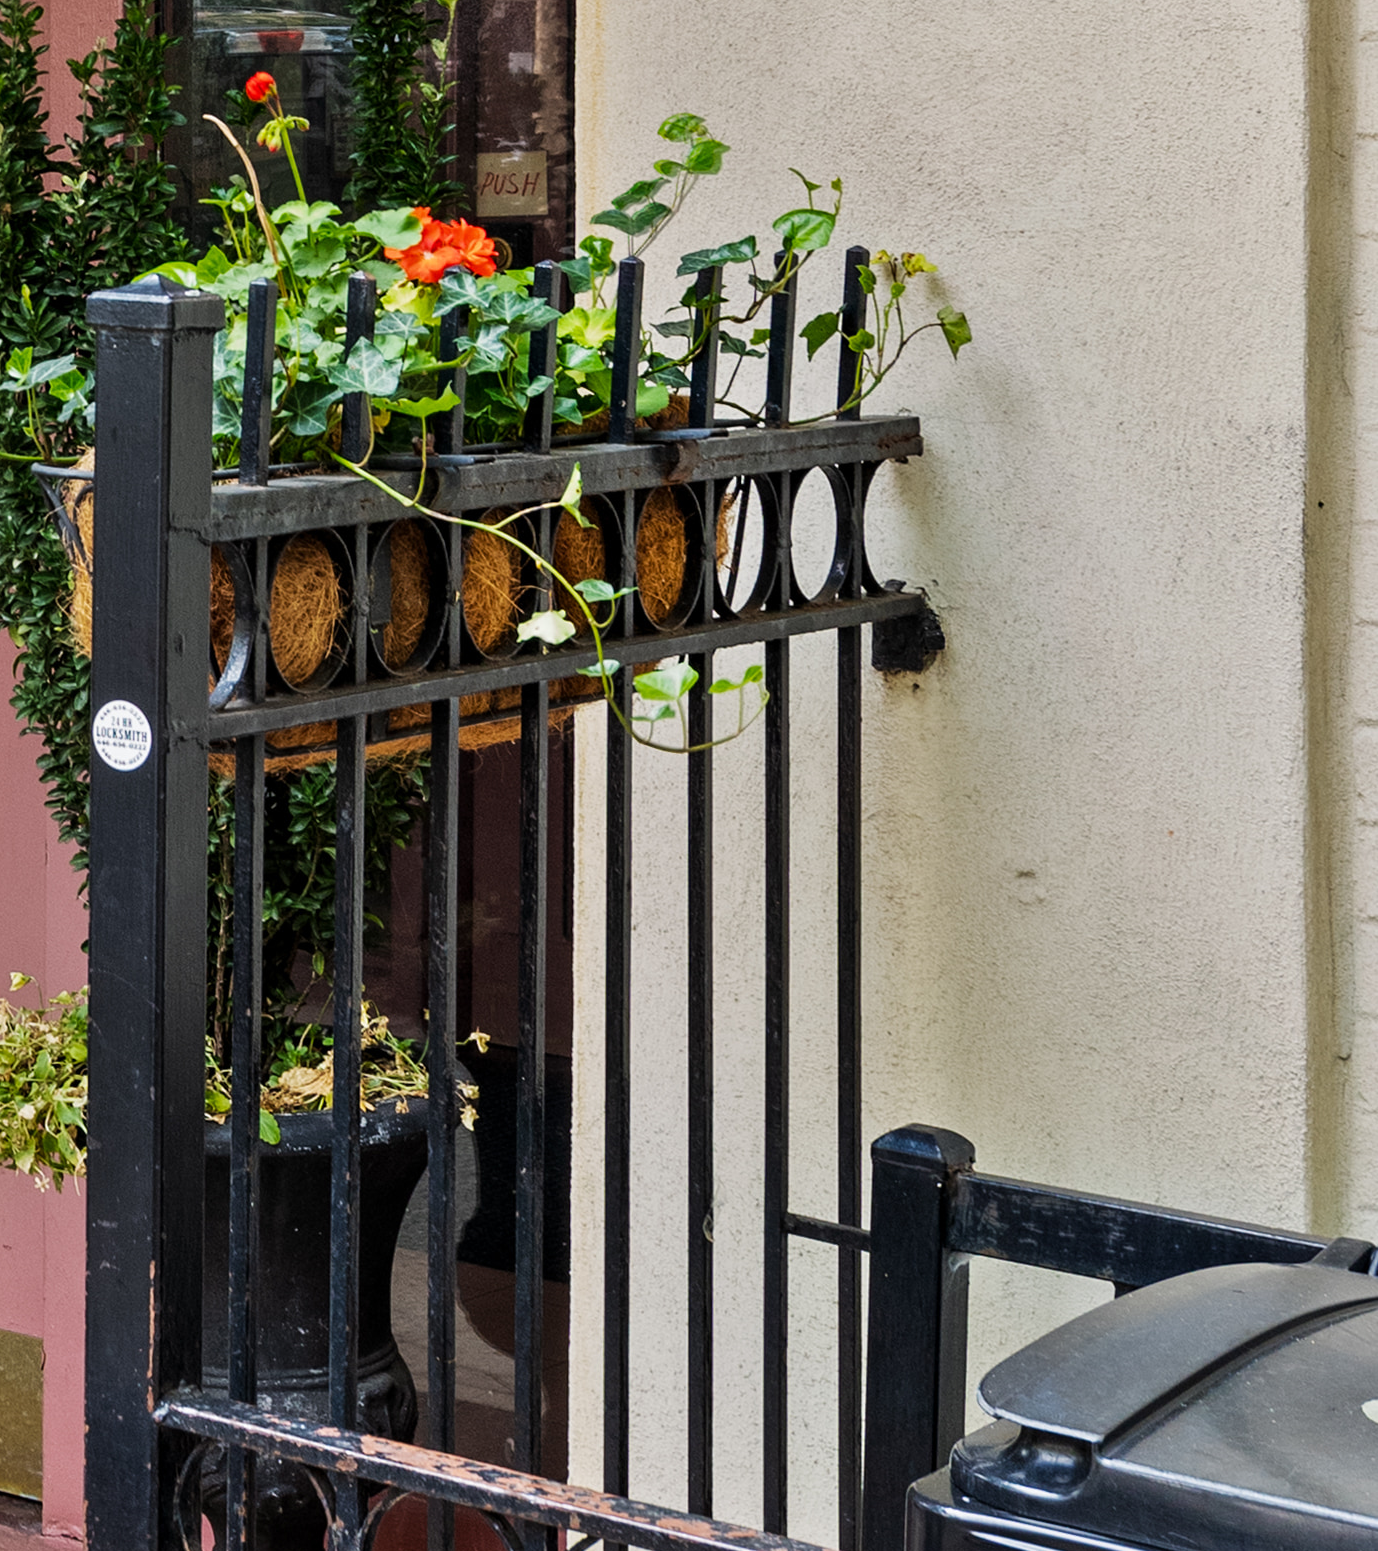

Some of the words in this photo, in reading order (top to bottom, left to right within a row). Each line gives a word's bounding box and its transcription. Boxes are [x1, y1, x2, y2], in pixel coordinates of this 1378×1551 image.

[480, 171, 540, 197] PUSH
[111, 715, 120, 726] 24
[123, 717, 133, 728] HR
[96, 725, 147, 743] LOCKSMITH
